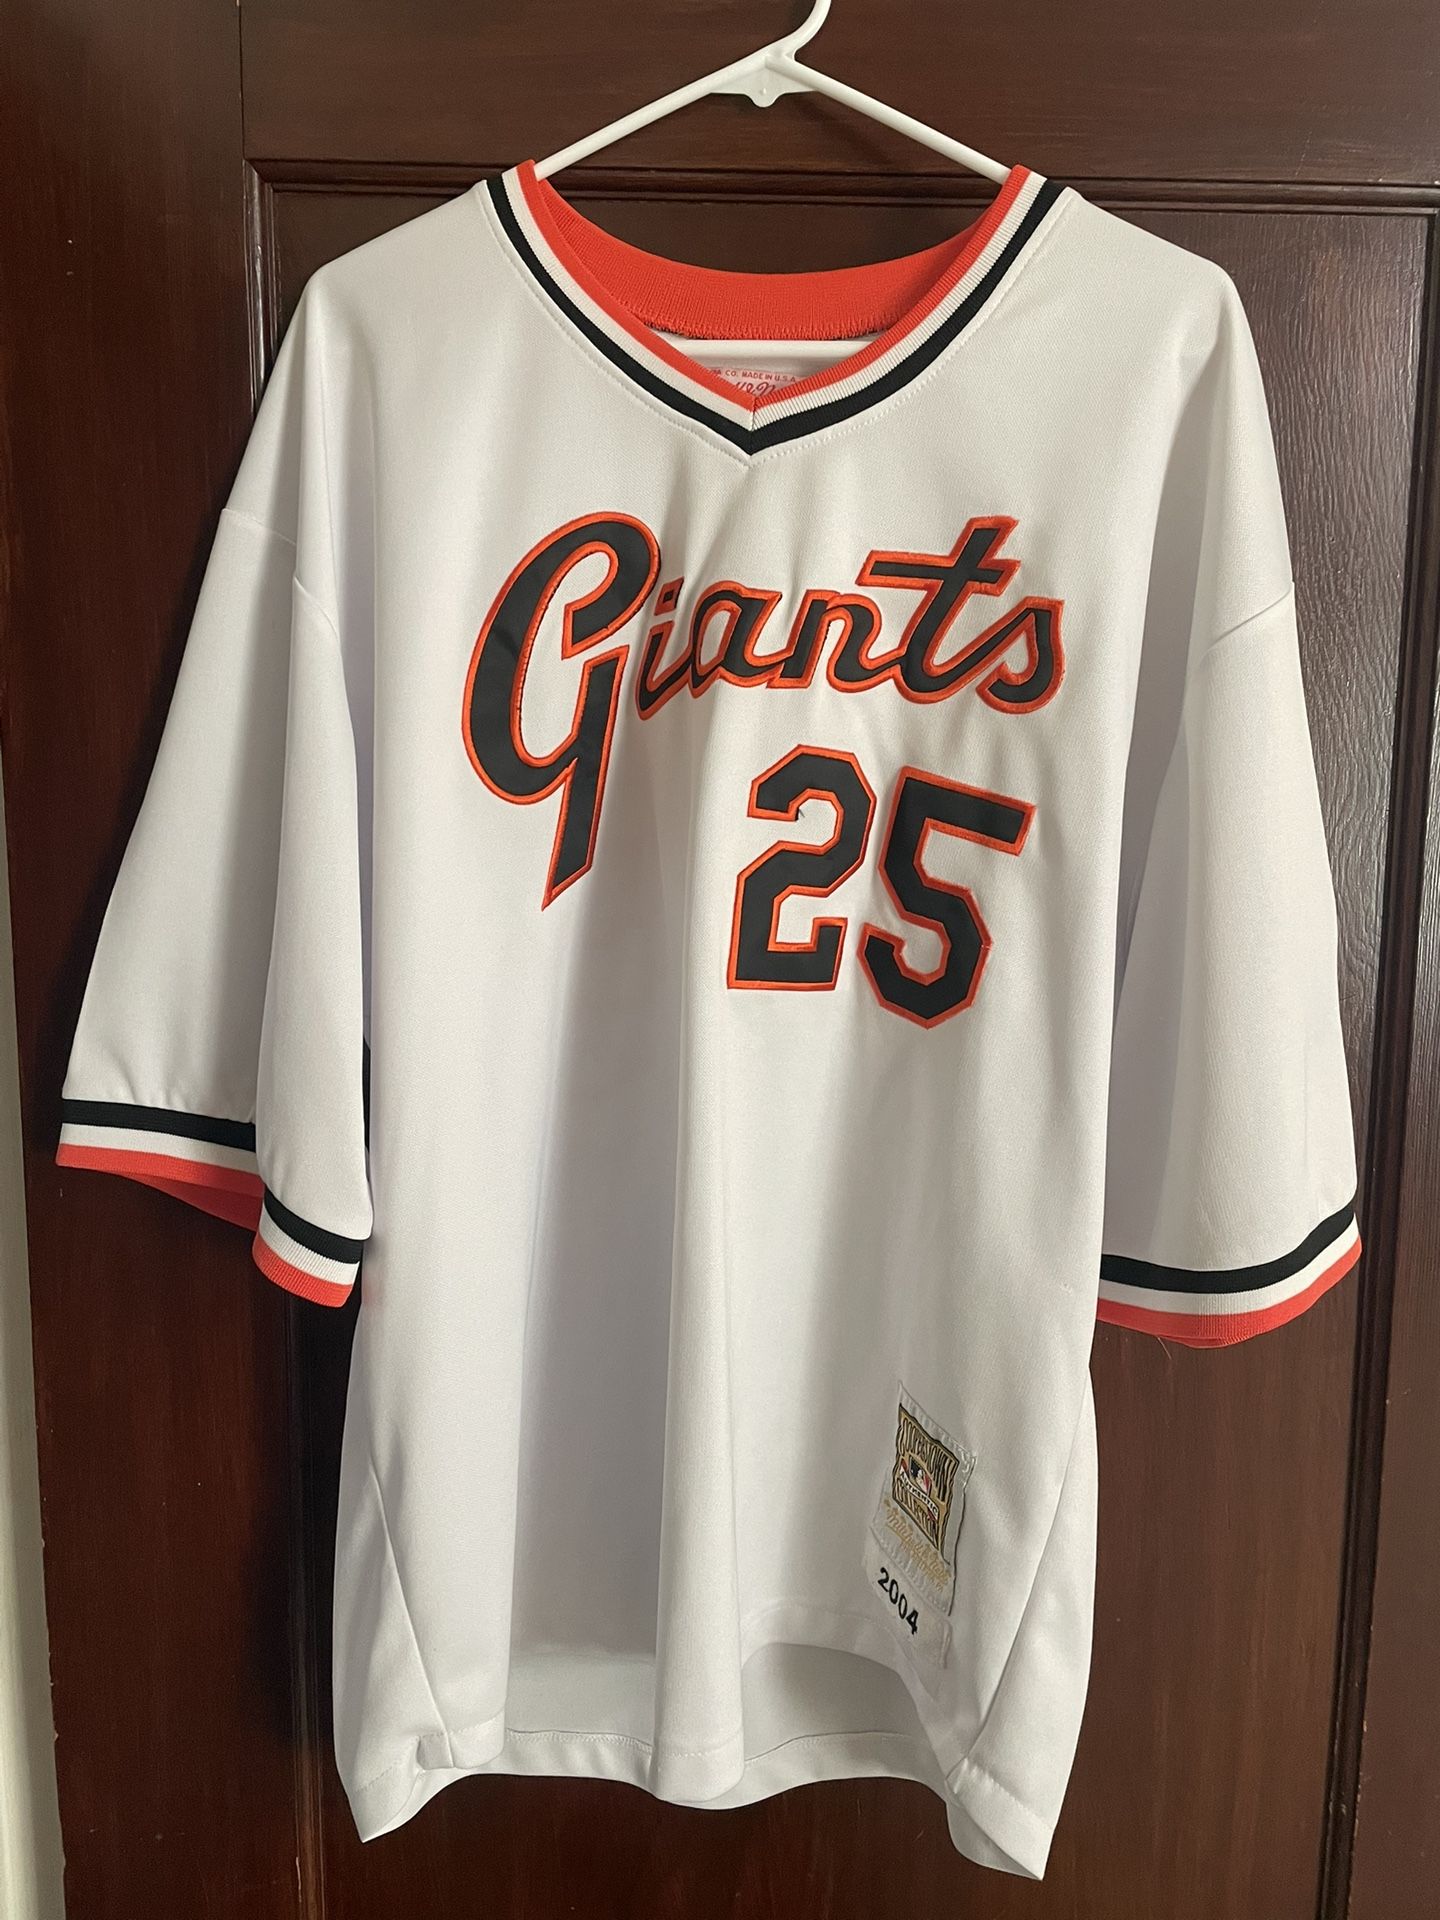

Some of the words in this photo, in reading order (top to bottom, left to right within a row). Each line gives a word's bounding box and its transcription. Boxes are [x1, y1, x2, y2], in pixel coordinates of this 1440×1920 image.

[742, 370, 763, 380] MADE
[462, 511, 1064, 911] Giants
[727, 745, 1036, 1029] 25
[899, 1468, 939, 1516] AUTHENTIC
[877, 1567, 919, 1635] 2004
